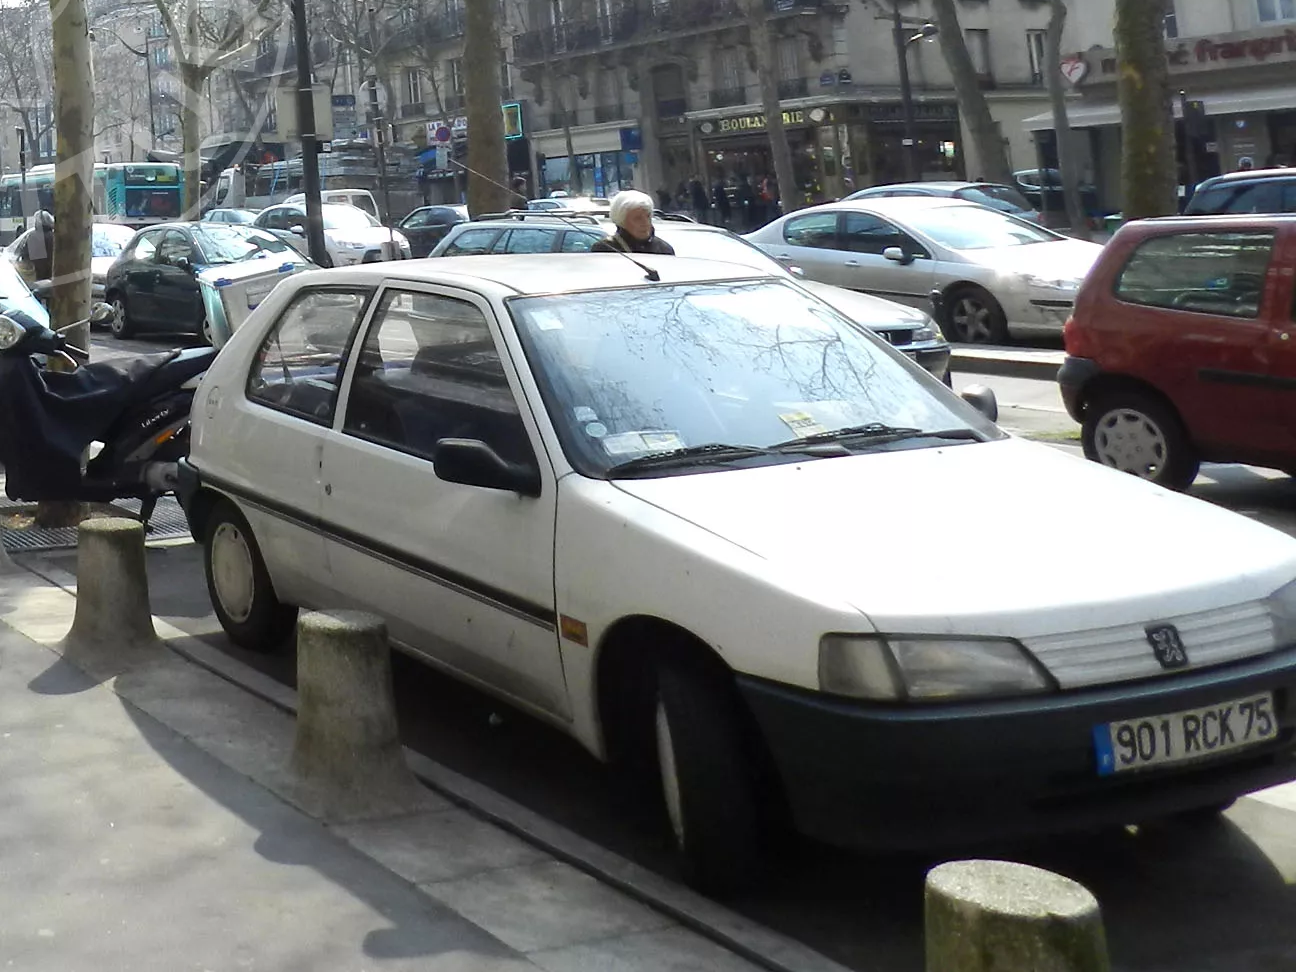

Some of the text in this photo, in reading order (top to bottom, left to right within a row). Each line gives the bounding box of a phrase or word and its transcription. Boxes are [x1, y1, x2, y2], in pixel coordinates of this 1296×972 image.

[719, 111, 804, 132] BOULANRIE
[1116, 697, 1273, 765] 901 RCK 75
